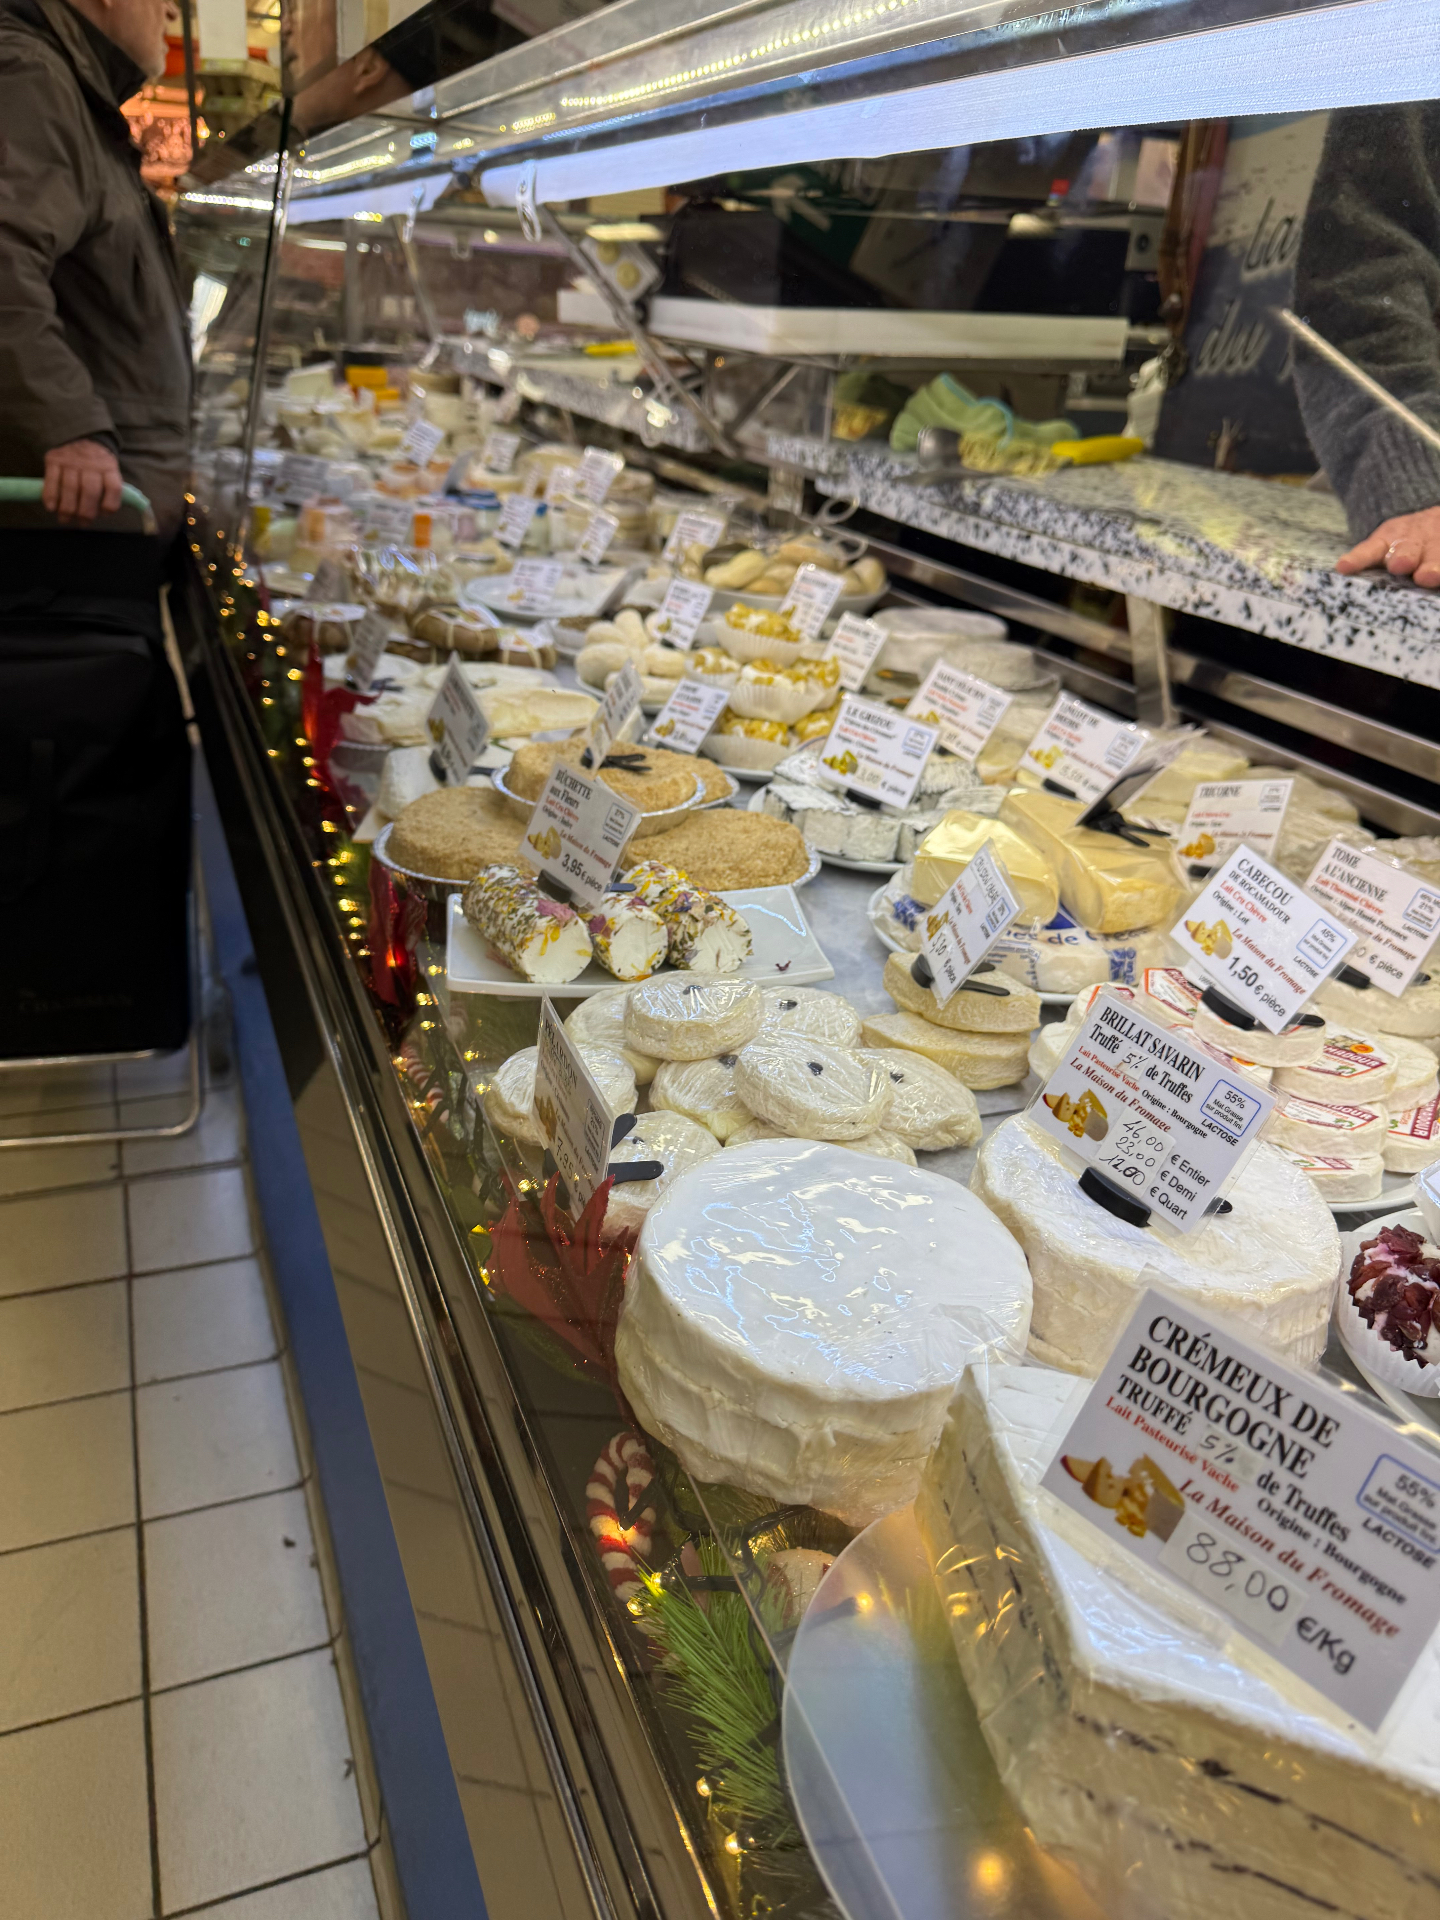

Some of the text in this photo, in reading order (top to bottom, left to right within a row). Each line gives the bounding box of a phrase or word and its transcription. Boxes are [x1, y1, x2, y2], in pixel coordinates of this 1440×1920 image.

[562, 853, 584, 877] 3,95
[585, 875, 602, 892] pièce
[1237, 858, 1293, 906] CABECOU
[1331, 848, 1361, 869] TOME
[1212, 890, 1235, 913] Origine
[1237, 912, 1250, 925] Lot
[1220, 880, 1268, 923] Lait Cru Chèvre
[1229, 870, 1291, 924] DE ROCAMADOUR
[1047, 933, 1079, 946] de
[1232, 927, 1306, 995] La Maison du Fromage
[1293, 955, 1320, 979] LACTOSE
[1228, 956, 1286, 1017] 1,50 € pièce
[1376, 959, 1403, 980] pièce
[1089, 1024, 1193, 1103] Truffé 5% de Truffes
[1100, 1006, 1206, 1082] BRILLAT SAVARIN
[1070, 1057, 1171, 1132] La Maison du Fromage
[1078, 1045, 1091, 1058] Lait
[1121, 1073, 1140, 1092] Vache
[1142, 1089, 1166, 1112] Origine
[1170, 1107, 1208, 1139] Bourgogne
[1205, 1103, 1214, 1112] sur
[1213, 1108, 1233, 1126] produit
[1225, 1090, 1245, 1109] 55%
[1123, 1120, 1210, 1187] 46,00 € Entier
[1201, 1118, 1239, 1146] LACTOSE
[1115, 1136, 1198, 1202] 23,00 € Demi
[1150, 1186, 1160, 1197] €
[1158, 1193, 1188, 1220] Quart
[1149, 1316, 1340, 1448] CRÉMEUX DE
[1128, 1344, 1315, 1479] BOURGOGNE
[1105, 1396, 1132, 1421] Lait
[1201, 1459, 1239, 1492] Vache
[1117, 1374, 1351, 1542] TRUFFÉ 5% de Truffes
[1395, 1474, 1436, 1508] 55%
[1179, 1478, 1401, 1638] La Maison du Fromage
[1257, 1498, 1312, 1541] Origine
[1323, 1542, 1407, 1605] Bourgogne
[1362, 1517, 1437, 1570] LACTOSE
[1187, 1533, 1356, 1675] 88,00 €/Kg
